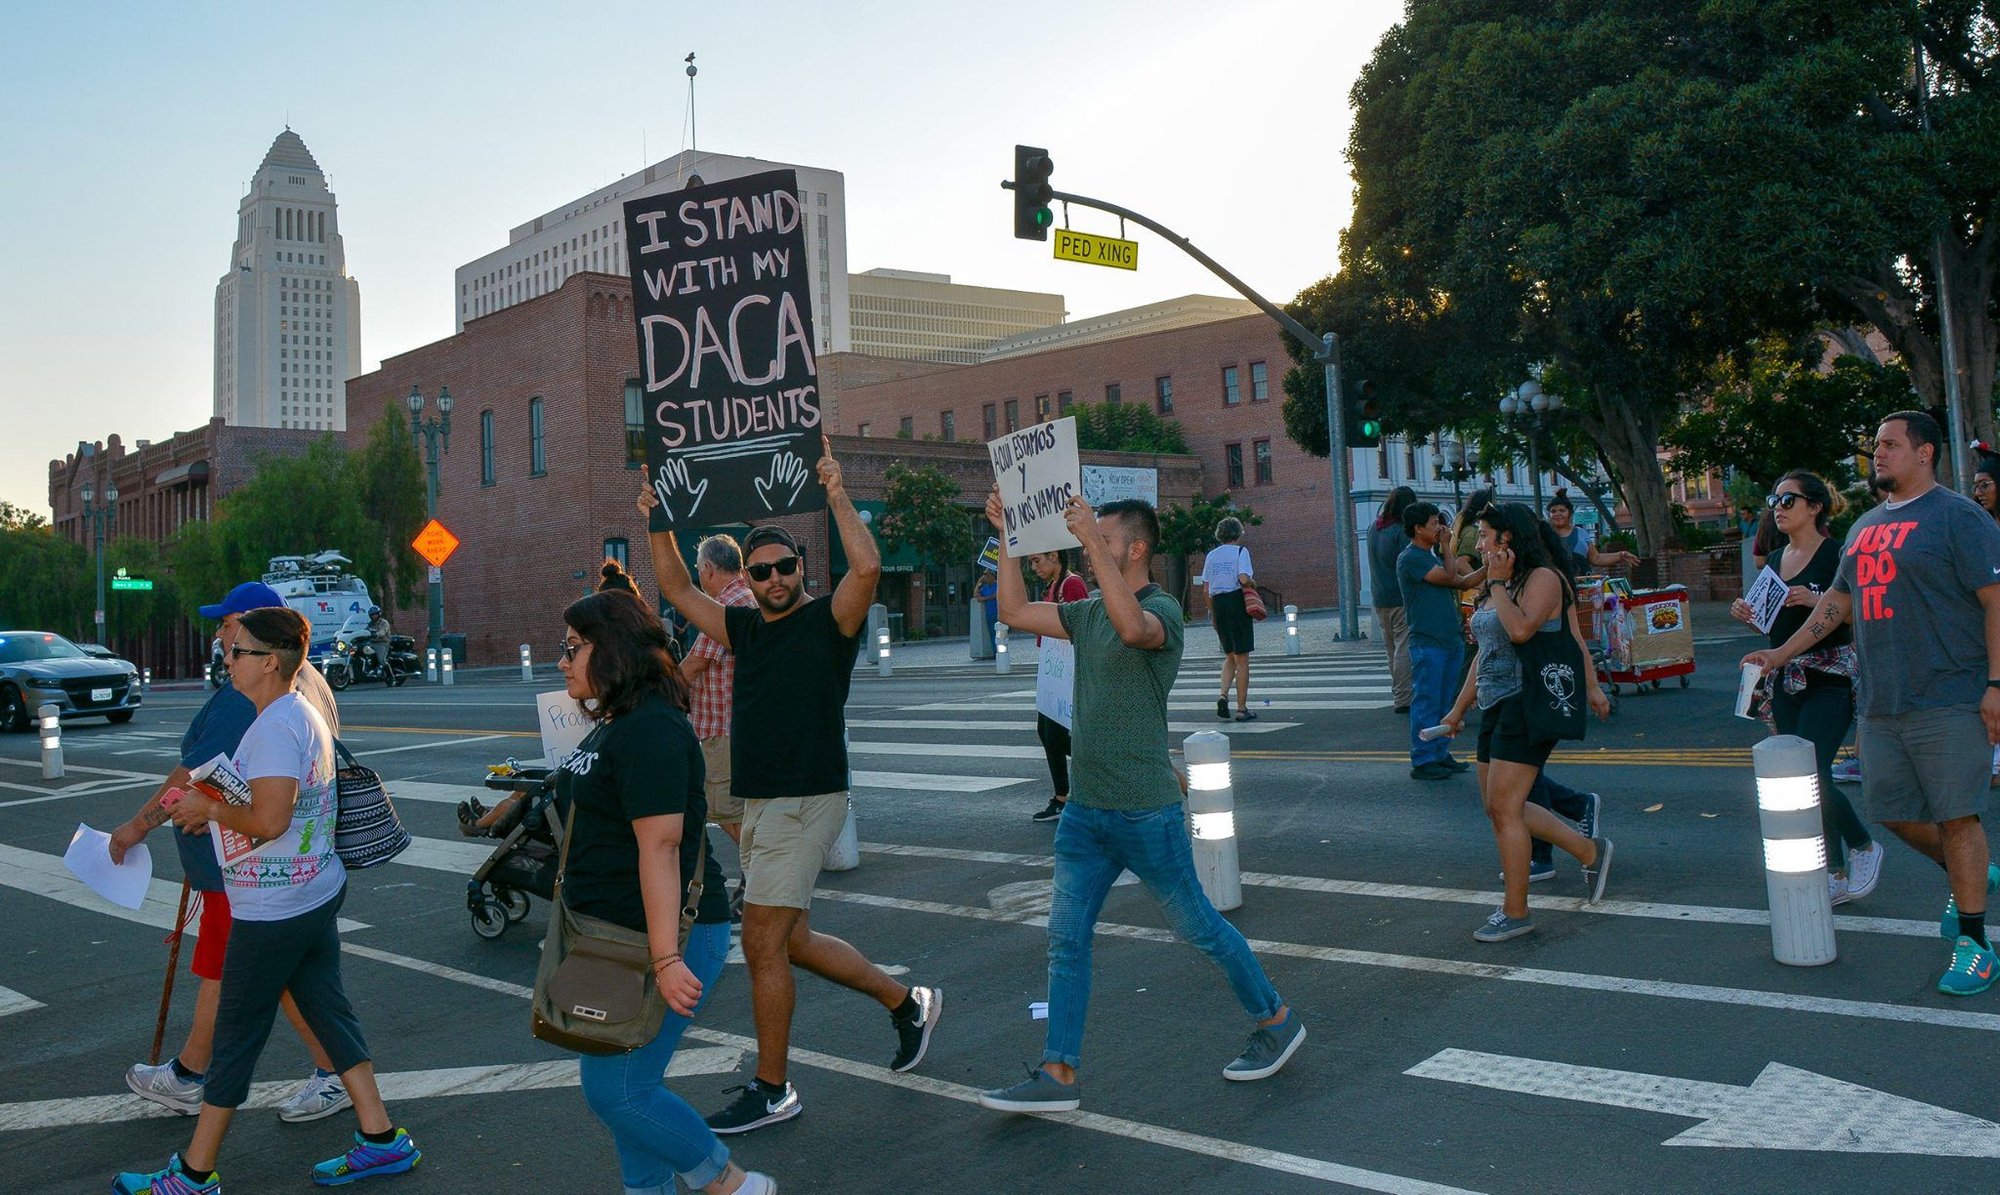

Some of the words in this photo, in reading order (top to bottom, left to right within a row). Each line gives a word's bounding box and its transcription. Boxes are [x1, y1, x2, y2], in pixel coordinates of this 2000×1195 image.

[636, 211, 670, 254] I
[679, 190, 801, 247] STAND
[1061, 236, 1091, 257] PED
[1098, 241, 1131, 264] XING
[643, 256, 738, 301] WITH
[752, 247, 789, 280] MY
[641, 291, 816, 392] DACA
[656, 385, 821, 447] STUDENTS
[1012, 423, 1055, 461] ESTAMOS
[1018, 462, 1026, 493] Y
[1004, 507, 1017, 536] NO
[1017, 496, 1035, 528] NOS
[1033, 482, 1072, 519] VAMOS
[1846, 521, 1919, 556] JUST
[1857, 551, 1897, 586] DO
[1862, 585, 1894, 621] IT.
